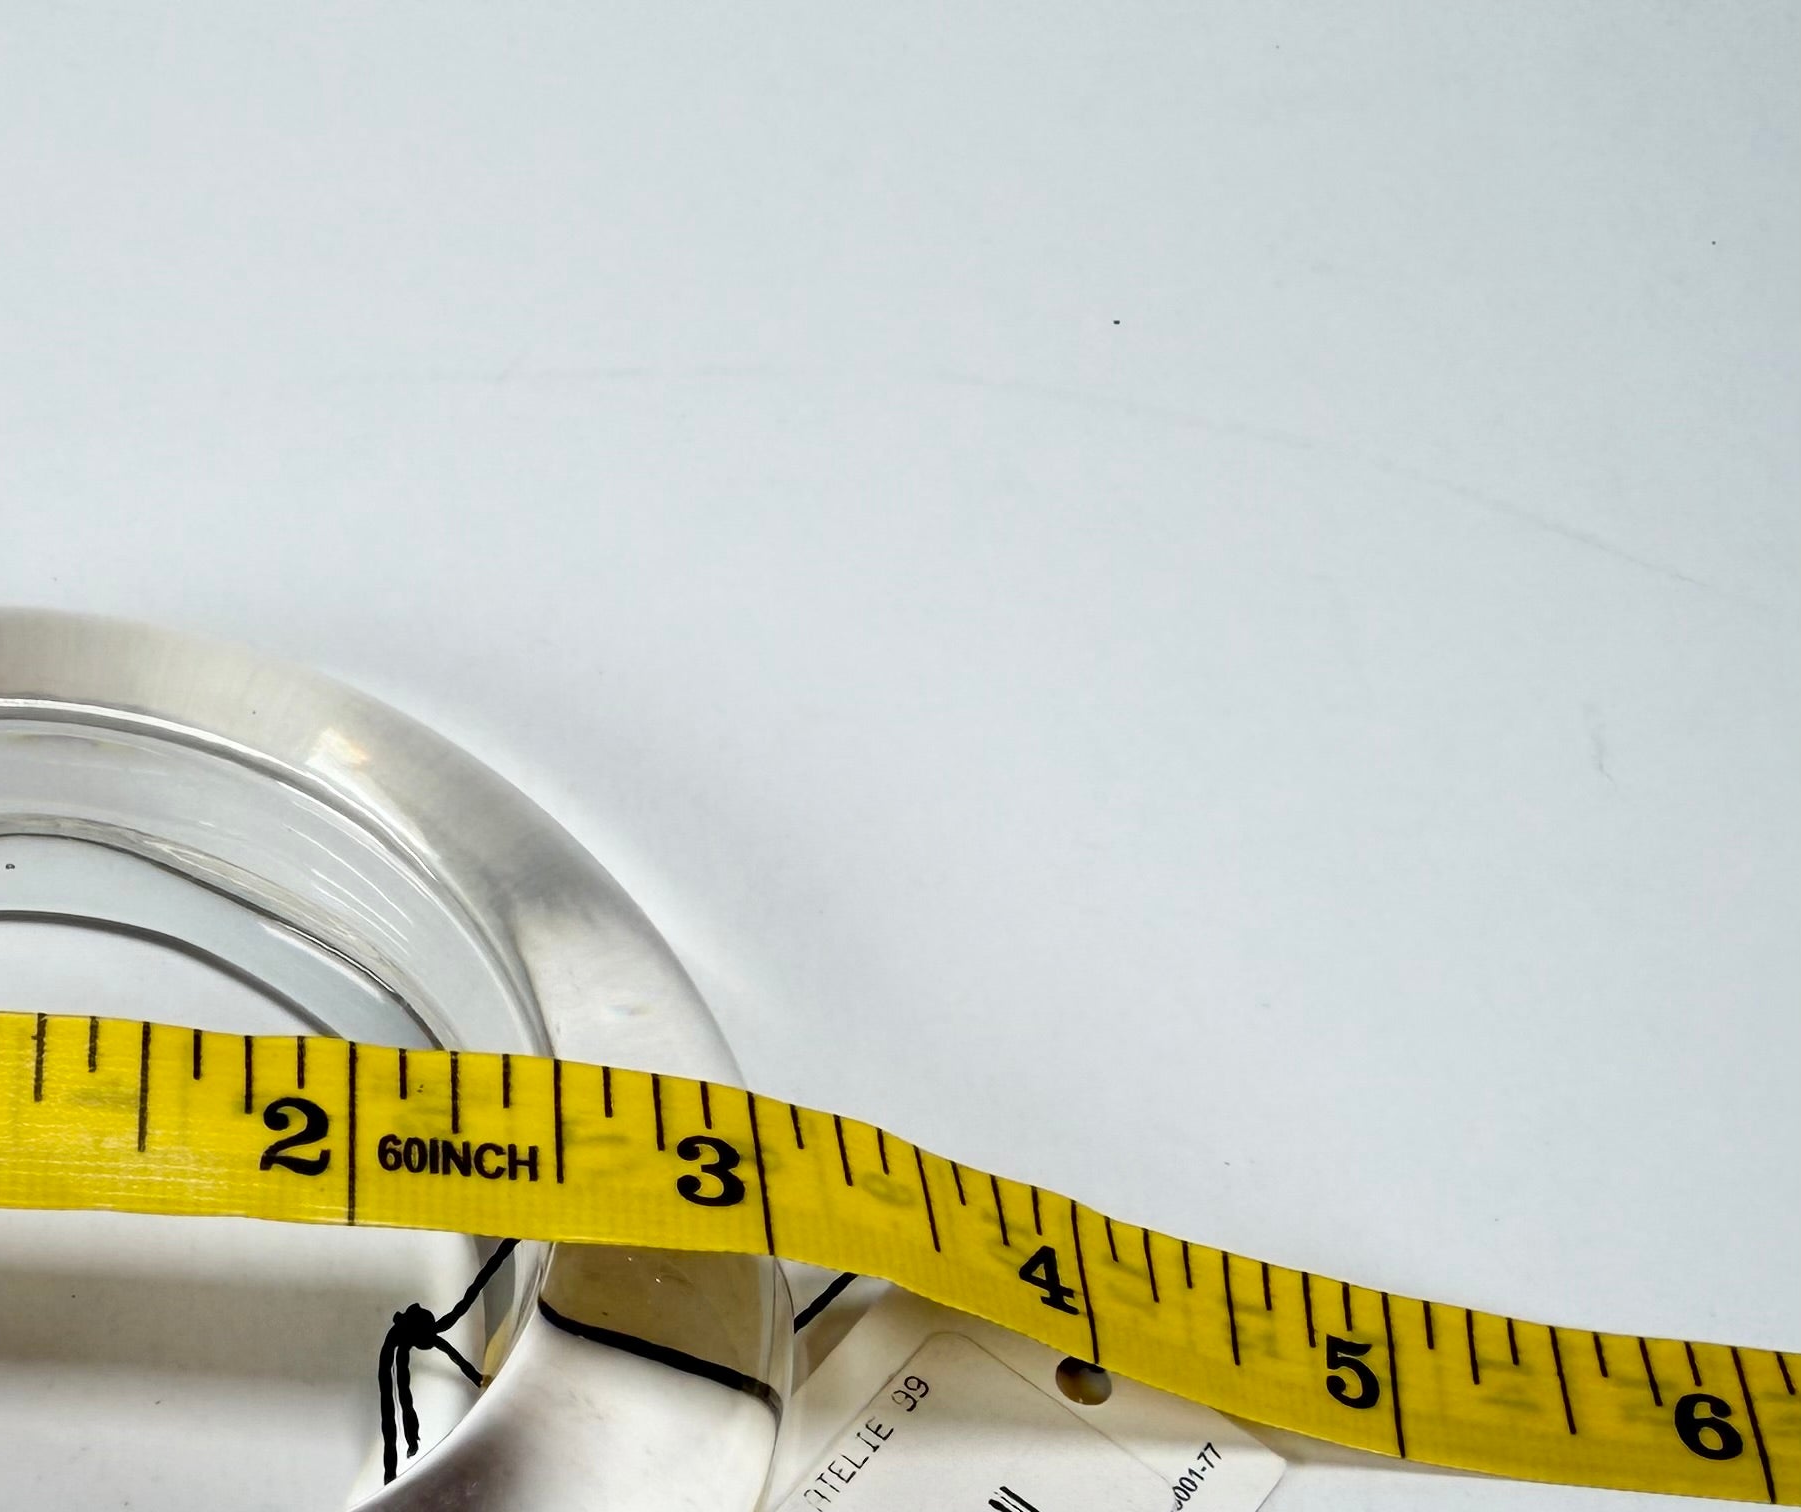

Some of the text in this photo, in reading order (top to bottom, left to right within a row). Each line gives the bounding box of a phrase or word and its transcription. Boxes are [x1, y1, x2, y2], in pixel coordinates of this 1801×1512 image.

[260, 1097, 332, 1176] 2
[376, 1132, 540, 1183] 60INCH
[676, 1134, 748, 1207] 3
[1017, 1245, 1080, 1315] 4
[1326, 1336, 1379, 1409] 5
[1674, 1393, 1744, 1461] 6
[803, 1416, 894, 1512] ATELIE
[891, 1375, 929, 1412] 99
